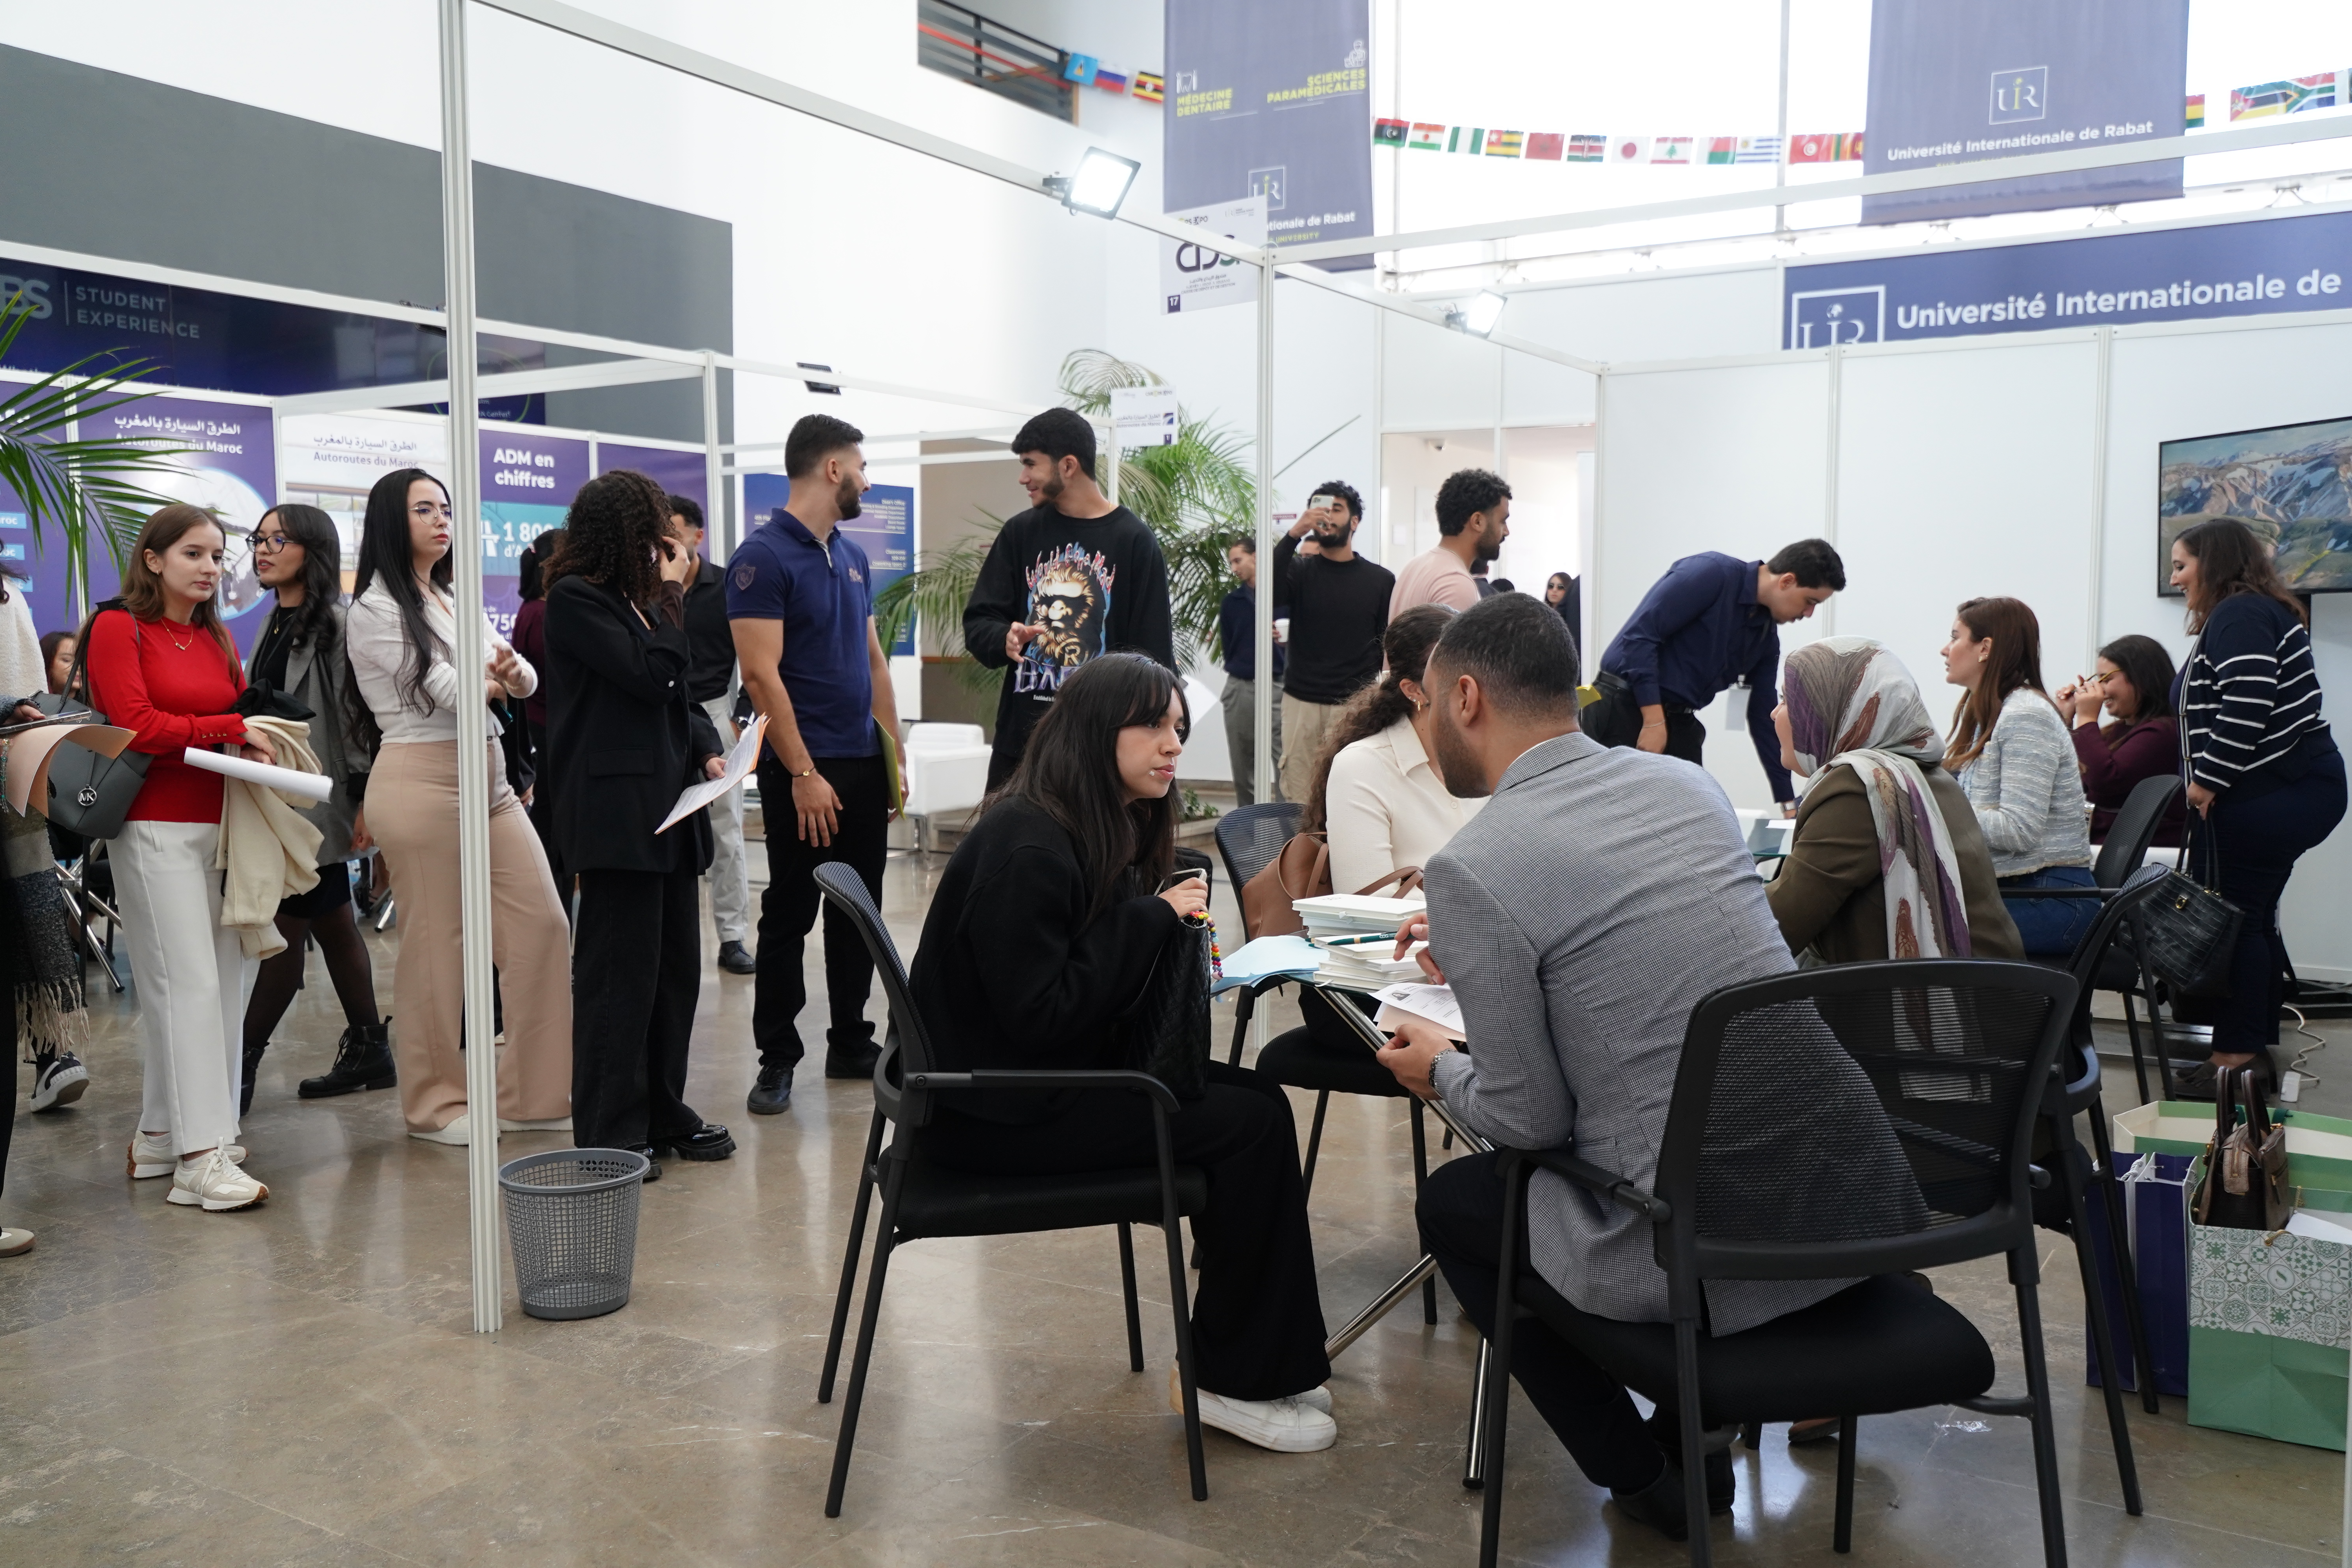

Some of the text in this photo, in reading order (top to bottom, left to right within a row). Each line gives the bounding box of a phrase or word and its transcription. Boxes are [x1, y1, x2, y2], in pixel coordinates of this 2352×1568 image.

[1307, 68, 1366, 87] SCIENCES
[1177, 88, 1232, 107] MÉDECINE
[1267, 79, 1366, 104] PARAMÉDICALES
[1177, 100, 1231, 117] DENTAIRE
[1887, 140, 1962, 161] Université
[1966, 129, 2075, 153] Internationale
[2078, 125, 2101, 140] de
[2105, 121, 2153, 138] Rabat
[1307, 216, 1322, 227] de
[1323, 211, 1356, 225] Rabat
[76, 287, 166, 312] STUDENT
[1170, 297, 1178, 307] 17
[1897, 269, 2342, 329] Université Internationale de
[77, 309, 200, 339] EXPERIENCE
[114, 414, 241, 436] الطرق السيارة بالمغرب
[206, 440, 243, 454] Maroc
[314, 434, 417, 452] الطرق السيارة بالمغرب
[314, 452, 418, 469] Autoroutes du Maroc
[493, 448, 555, 468] ADM en
[495, 469, 555, 488] chiffres
[80, 793, 94, 802] MK
